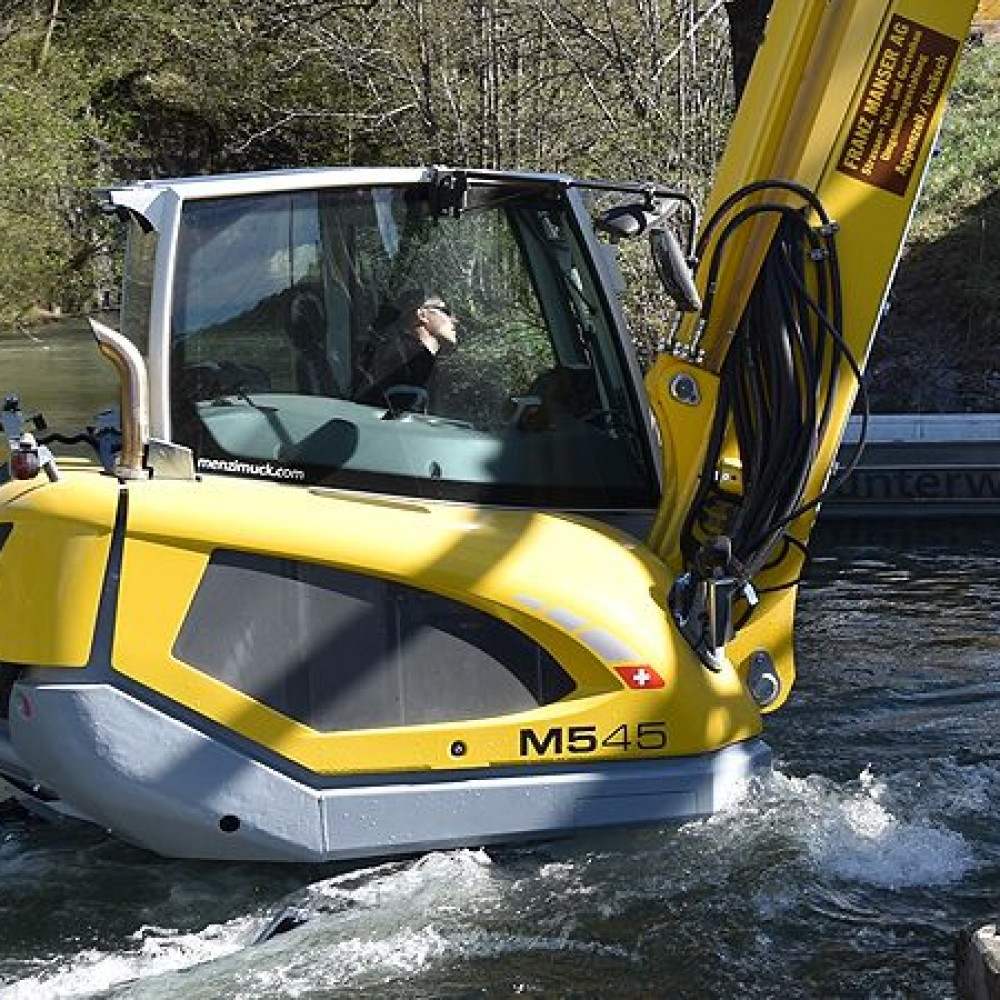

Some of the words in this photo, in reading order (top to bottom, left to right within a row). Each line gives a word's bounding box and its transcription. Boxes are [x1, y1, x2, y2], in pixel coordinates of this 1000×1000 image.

[844, 115, 873, 170] FRANZ
[864, 49, 898, 114] MANSER
[890, 22, 910, 48] AG
[197, 458, 305, 480] menzimuck.com
[519, 722, 668, 756] M545
